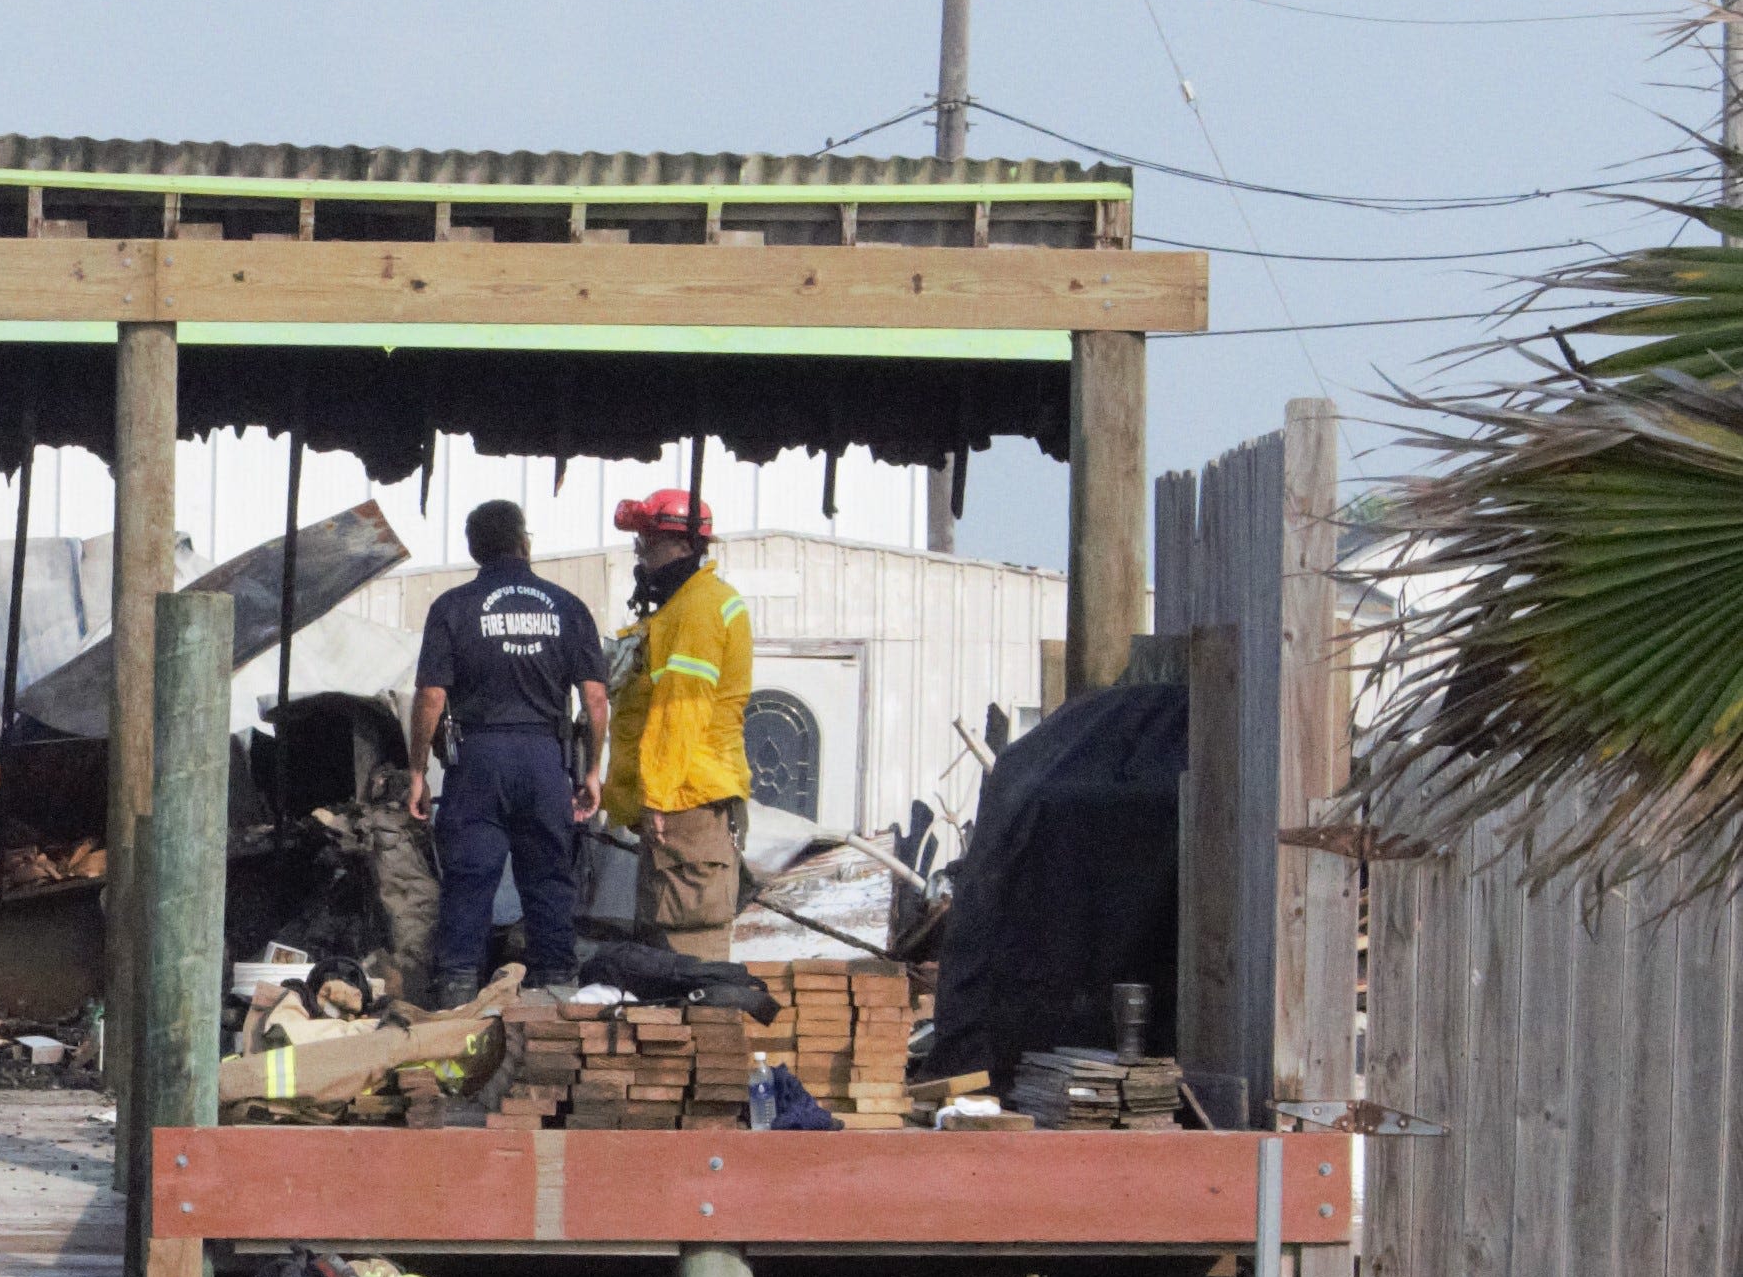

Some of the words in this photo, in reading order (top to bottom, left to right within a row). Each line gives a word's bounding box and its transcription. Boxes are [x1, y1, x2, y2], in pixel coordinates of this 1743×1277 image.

[482, 585, 515, 612] CORPUS
[516, 586, 556, 611] CHRISTI
[480, 613, 505, 637] FIRE
[506, 613, 561, 637] MARSHAL'S
[502, 641, 543, 655] OFFICE
